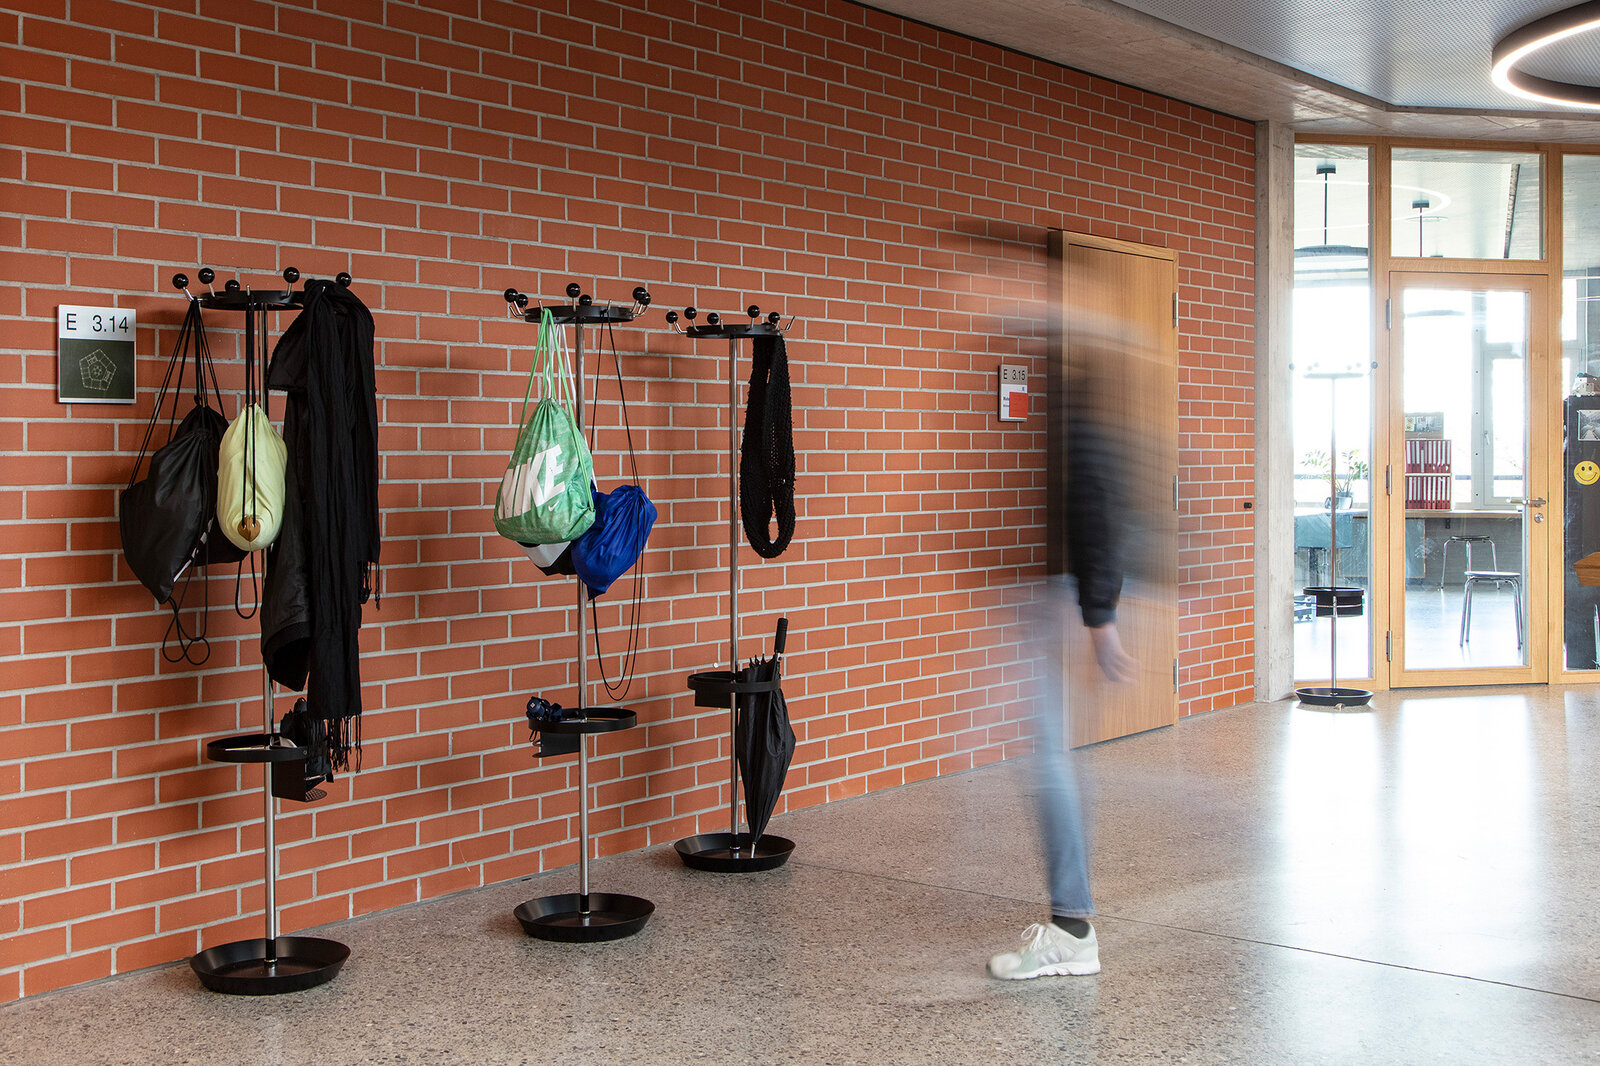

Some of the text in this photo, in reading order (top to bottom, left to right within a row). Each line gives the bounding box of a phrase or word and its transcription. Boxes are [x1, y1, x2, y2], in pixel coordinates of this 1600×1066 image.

[66, 313, 129, 333] E 3.14
[1003, 368, 1026, 380] E 3.15
[498, 444, 566, 521] NIKE
